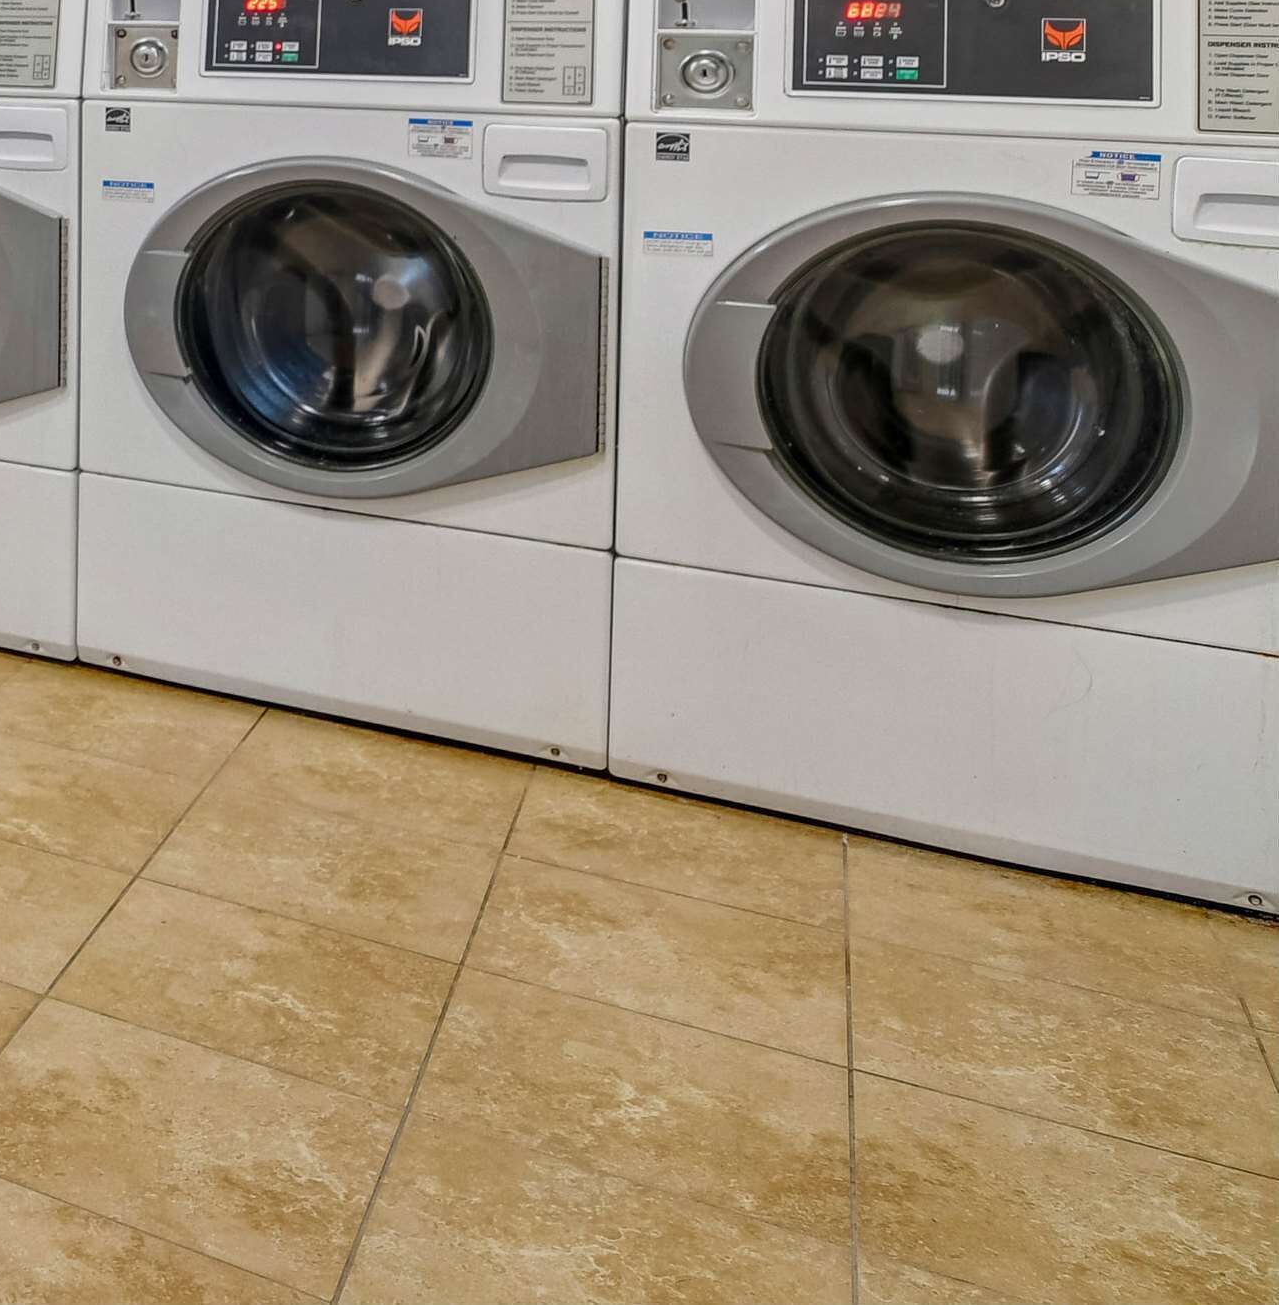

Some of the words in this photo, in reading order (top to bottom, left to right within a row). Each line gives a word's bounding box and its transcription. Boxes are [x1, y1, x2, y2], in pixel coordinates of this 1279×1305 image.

[387, 37, 421, 46] IPSO
[1041, 51, 1086, 62] IPSO
[1098, 151, 1138, 160] NOTICE
[652, 231, 703, 241] NOTICE
